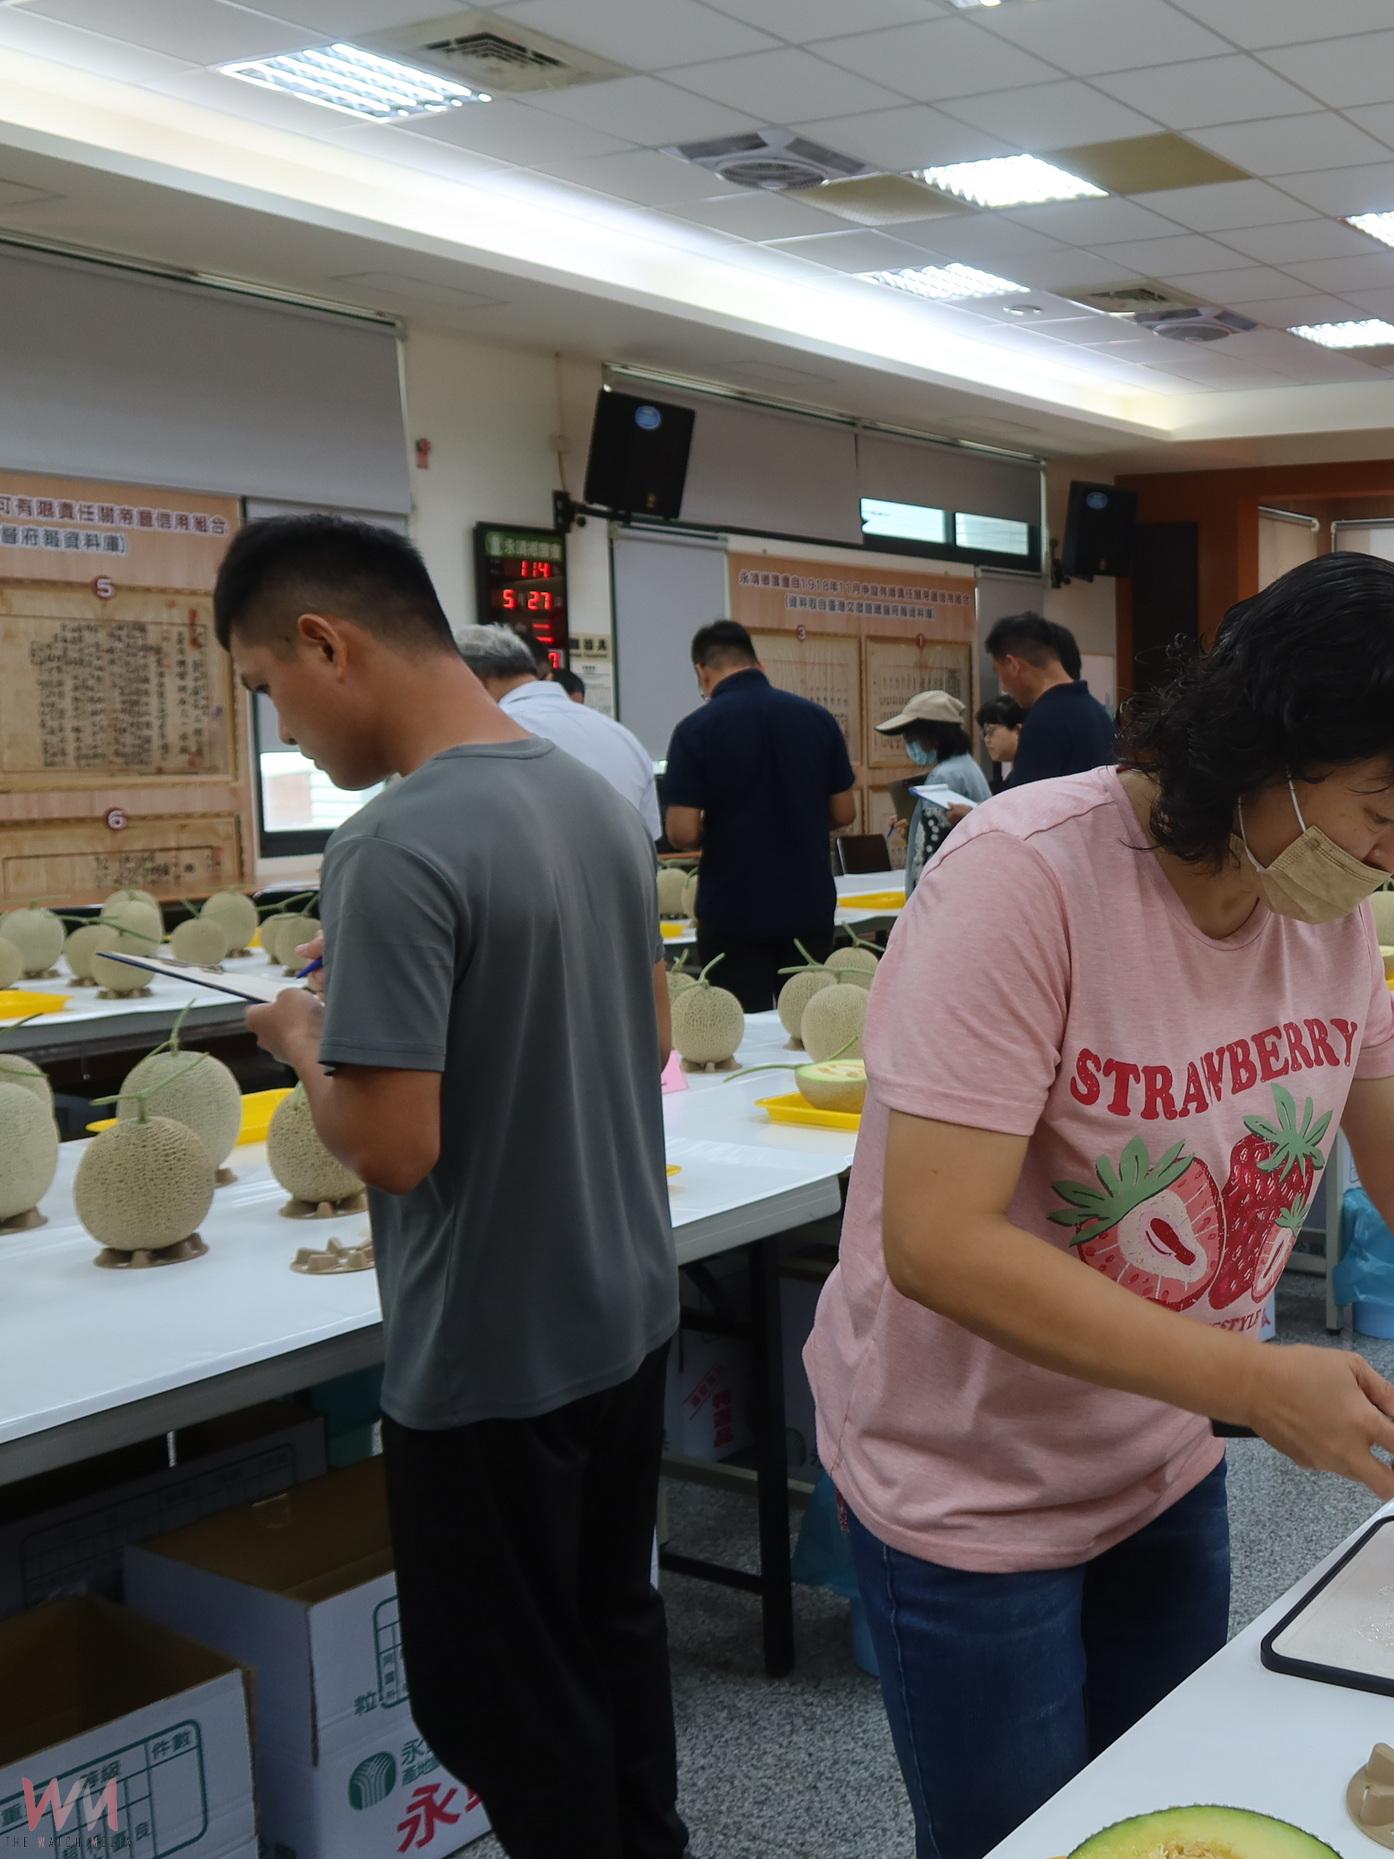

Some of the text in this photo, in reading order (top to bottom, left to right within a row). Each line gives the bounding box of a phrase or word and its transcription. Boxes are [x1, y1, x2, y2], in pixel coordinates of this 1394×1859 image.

[520, 560, 550, 578] 114
[96, 578, 113, 598] 5
[502, 588, 517, 609] 5
[527, 590, 552, 610] 27
[108, 809, 127, 829] 6
[1070, 1018, 1358, 1120] STRAWBERRY
[151, 1730, 193, 1760] 件數
